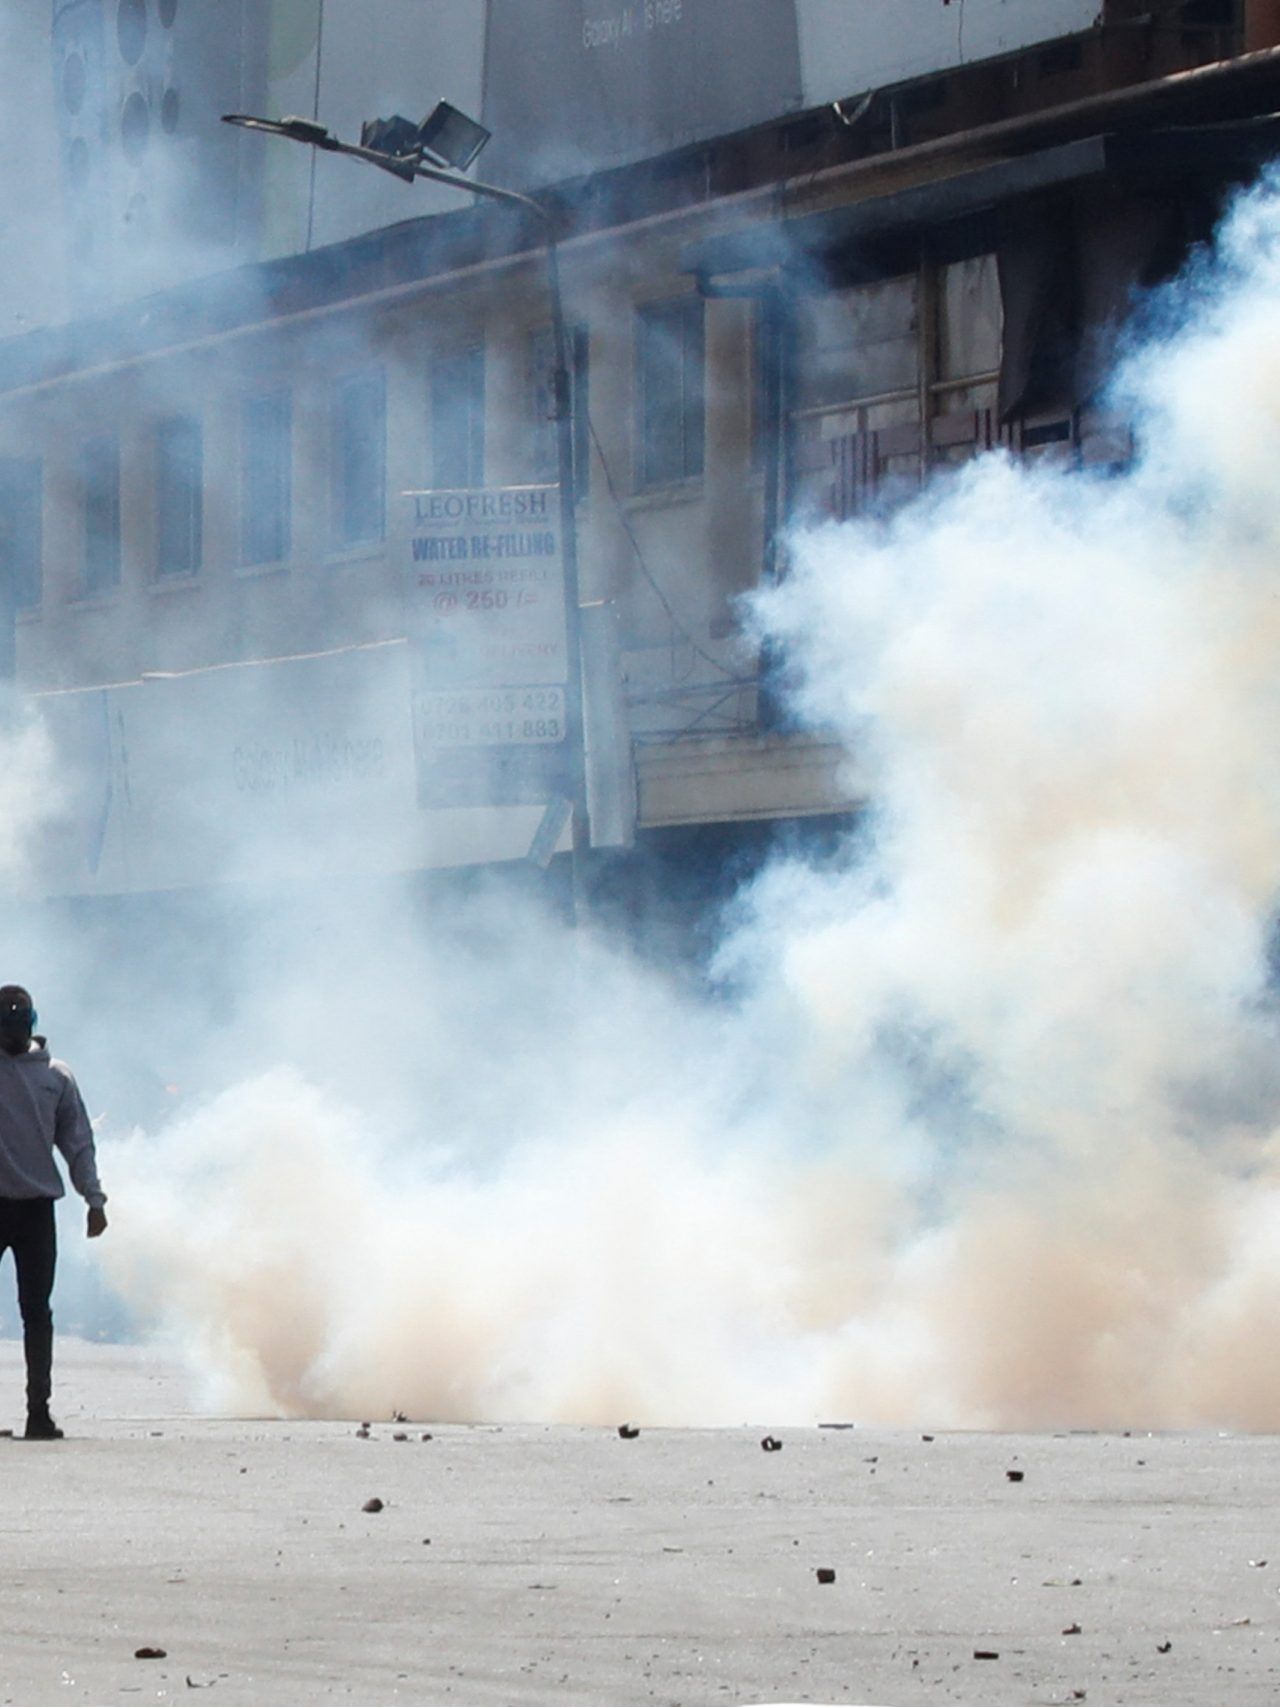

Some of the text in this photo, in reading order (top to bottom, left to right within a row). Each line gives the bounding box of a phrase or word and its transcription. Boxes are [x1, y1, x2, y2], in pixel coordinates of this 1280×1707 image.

[415, 491, 547, 519] LEOFRESH
[412, 531, 555, 562] WATER RE-FILLING
[465, 590, 508, 611] 250
[523, 718, 559, 738] 883
